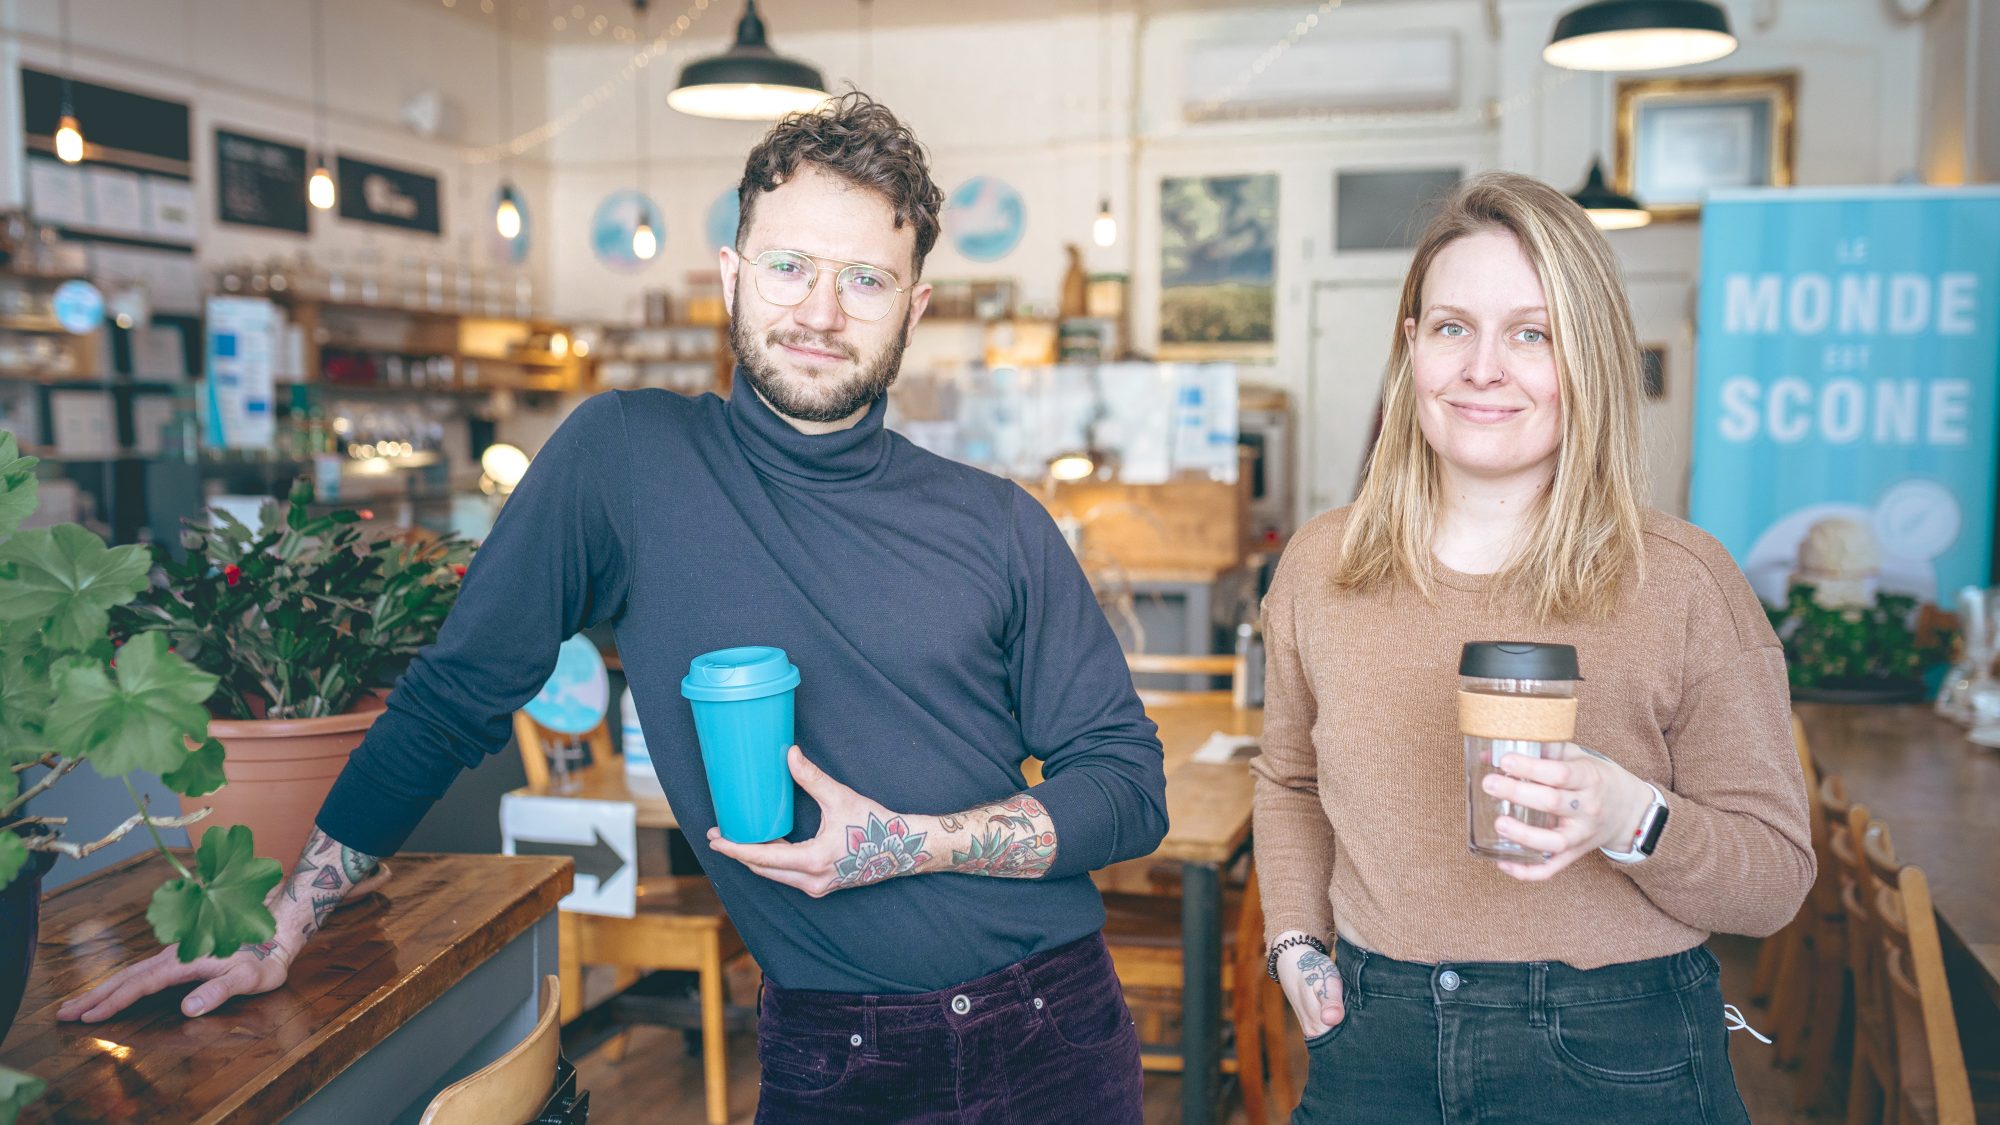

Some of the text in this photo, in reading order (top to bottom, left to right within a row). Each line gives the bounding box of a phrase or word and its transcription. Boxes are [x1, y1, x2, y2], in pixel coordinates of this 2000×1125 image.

[1837, 237, 1868, 263] LE
[1724, 273, 1977, 335] MONDE
[1824, 345, 1871, 370] EST
[1719, 376, 1970, 444] SCONE
